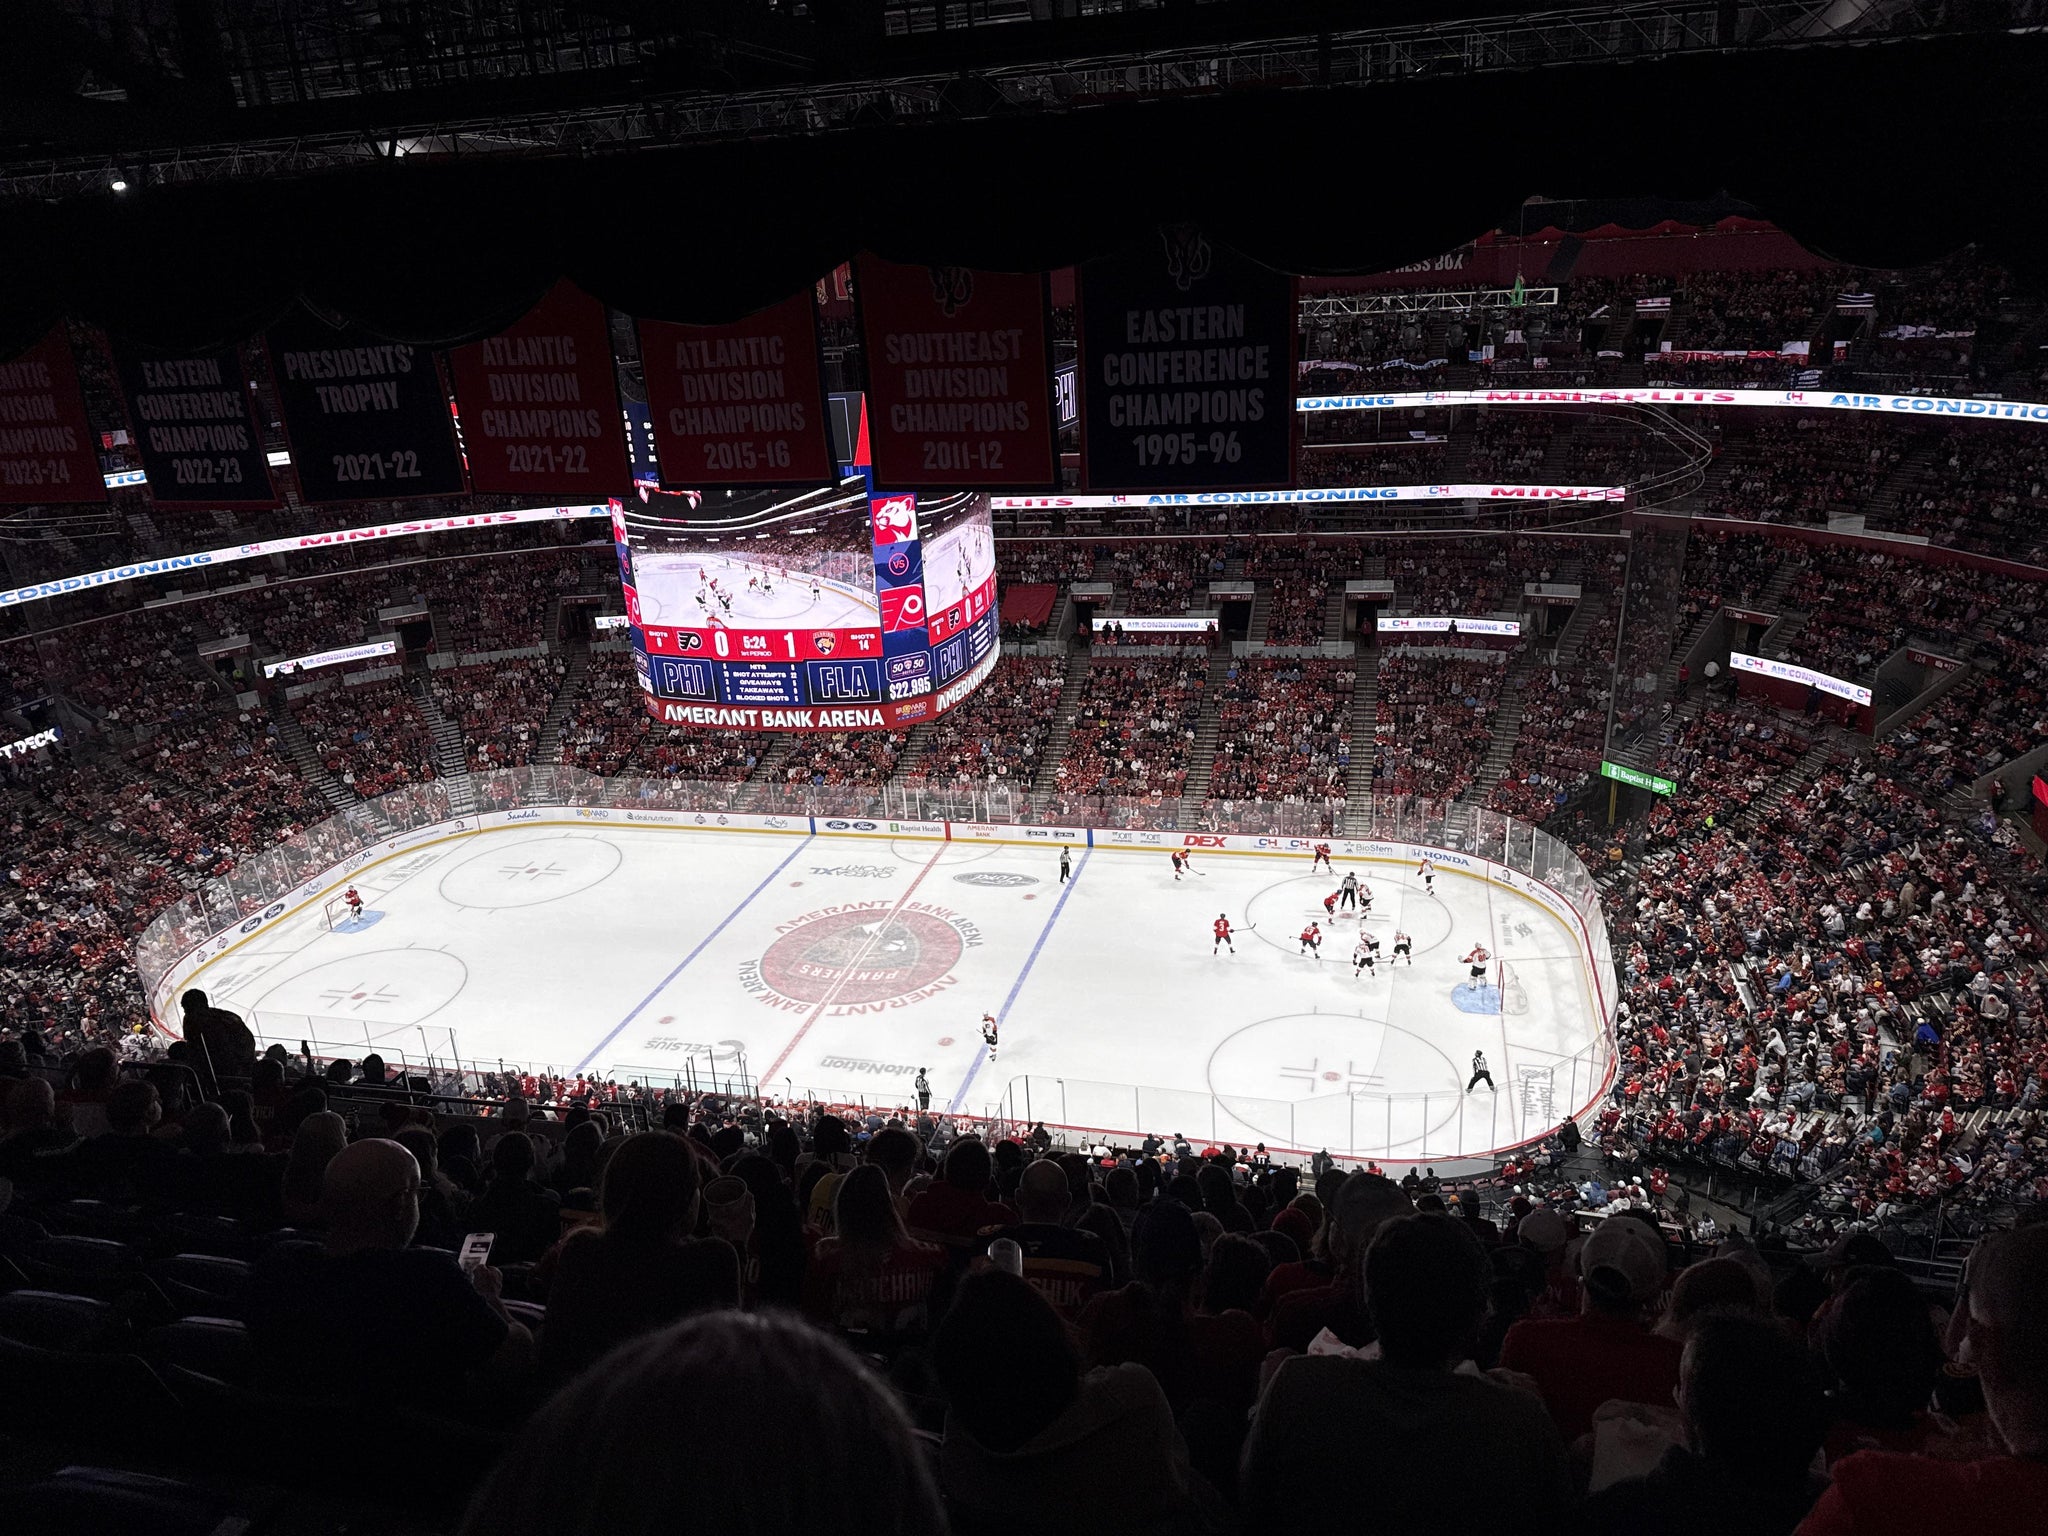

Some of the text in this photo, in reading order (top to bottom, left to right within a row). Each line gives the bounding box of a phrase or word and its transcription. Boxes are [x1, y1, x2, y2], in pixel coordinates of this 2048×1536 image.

[1127, 304, 1245, 343] EASTERN
[482, 336, 576, 365] ATLANTIC
[676, 336, 784, 369] ATLANTIC
[885, 329, 1023, 364] SOUTHEAST
[141, 359, 222, 388] EASTERN
[284, 344, 414, 380] PRESIDENTS'
[1104, 345, 1270, 387] CONFERENCE
[488, 373, 581, 402] DIVISION
[682, 370, 784, 402] DIVISION
[905, 366, 1008, 398] DIVISION
[136, 391, 245, 421] CONFERENCE
[316, 381, 399, 413] TROPHY
[1109, 388, 1265, 427] CHAMPIONS
[1487, 389, 1735, 402] MINI-SPLITS
[1830, 393, 1882, 408] AIR
[480, 408, 602, 437] CHAMPIONS
[670, 403, 806, 436] CHAMPIONS
[891, 401, 1030, 432] CHAMPIONS
[148, 425, 250, 452] CHAMPIONS
[648, 444, 655, 452] T
[1132, 432, 1242, 466] 1995-96
[333, 450, 422, 482] 2021-22
[506, 445, 589, 473] 2021-22
[703, 440, 790, 470] 2015-16
[923, 440, 1003, 469] 2011-12
[172, 458, 243, 484] 2022-23
[1148, 493, 1189, 505] AIR
[1197, 489, 1398, 504] CONDITIONING
[300, 512, 517, 546] MINI-SPLITS
[893, 560, 905, 569] VS
[1392, 619, 1409, 627] CH
[302, 658, 314, 667] AIR
[316, 648, 376, 664] CONDITIONING
[648, 630, 668, 638] SHOTS
[714, 631, 729, 656] 0
[743, 635, 767, 650] 5:24
[784, 632, 795, 658] 1
[858, 640, 870, 651] 14
[892, 659, 924, 673] 50 50
[940, 639, 963, 680] PHI
[663, 662, 706, 695] PHI
[819, 666, 870, 697] FLA
[889, 676, 931, 700] $22,995
[936, 667, 982, 712] AMERANT
[1732, 657, 1738, 665] G
[1745, 658, 1763, 668] CH
[1771, 665, 1787, 676] AIR
[1789, 669, 1851, 695] CONDITIONING
[665, 704, 885, 728] AMERANT BANK ARENA
[13, 728, 59, 754] DECK
[1620, 770, 1644, 785] Baptist
[507, 808, 541, 820] Sandals
[922, 824, 942, 832] Health
[1183, 834, 1228, 847] DEX
[1259, 837, 1278, 846] CH
[1290, 839, 1309, 847] CH
[1356, 842, 1393, 852] BioStem
[362, 850, 373, 862] XL
[1423, 851, 1471, 866] HONDA
[809, 867, 842, 876] XL
[775, 900, 983, 949] AMERANT BANK ARENA
[1218, 924, 1225, 932] 3
[799, 963, 900, 981] PANTHERS
[738, 958, 959, 1016] AMERANT BANK ARENA
[643, 1038, 713, 1053] CELSIUS
